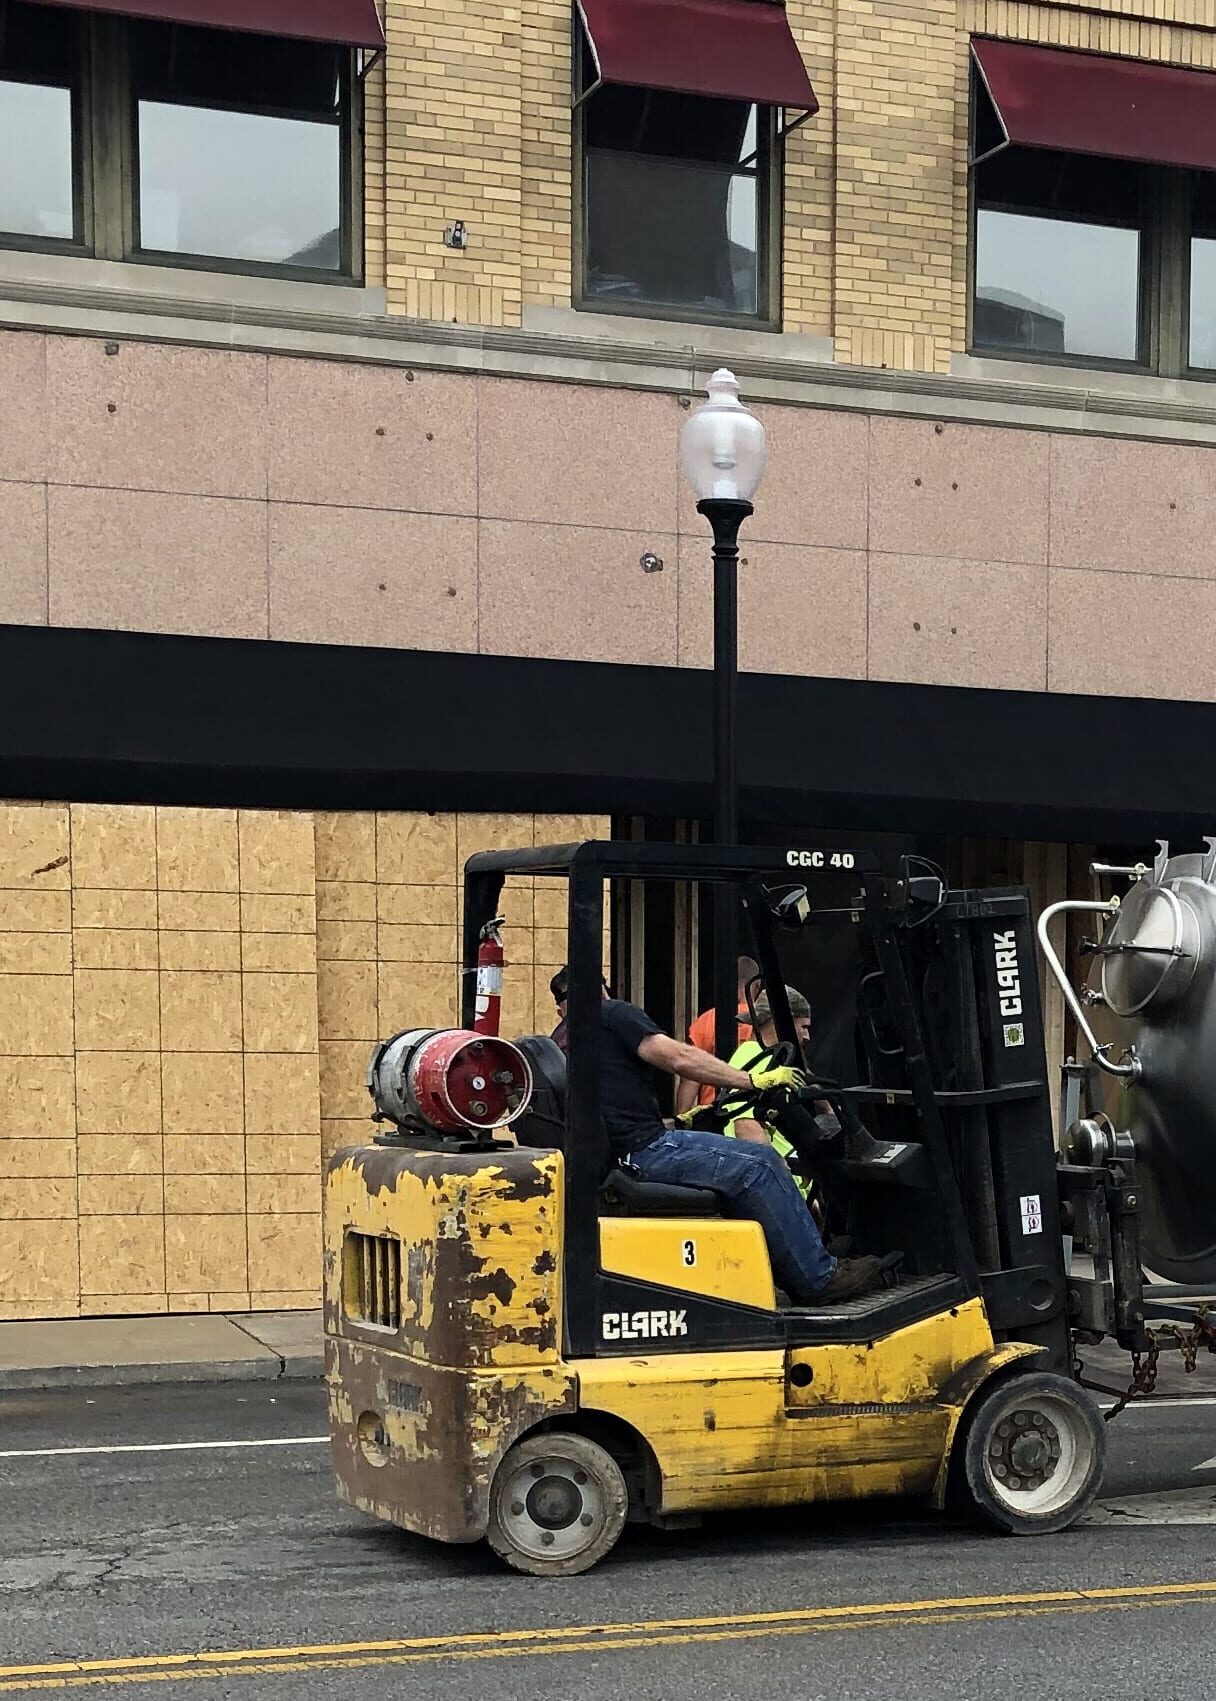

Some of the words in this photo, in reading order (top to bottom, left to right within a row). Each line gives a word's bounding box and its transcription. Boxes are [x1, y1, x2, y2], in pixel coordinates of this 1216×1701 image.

[786, 850, 825, 867] CGC
[830, 853, 855, 869] 40
[993, 930, 1023, 1017] CLARK
[684, 1240, 695, 1266] 3
[602, 1309, 688, 1340] CLARK
